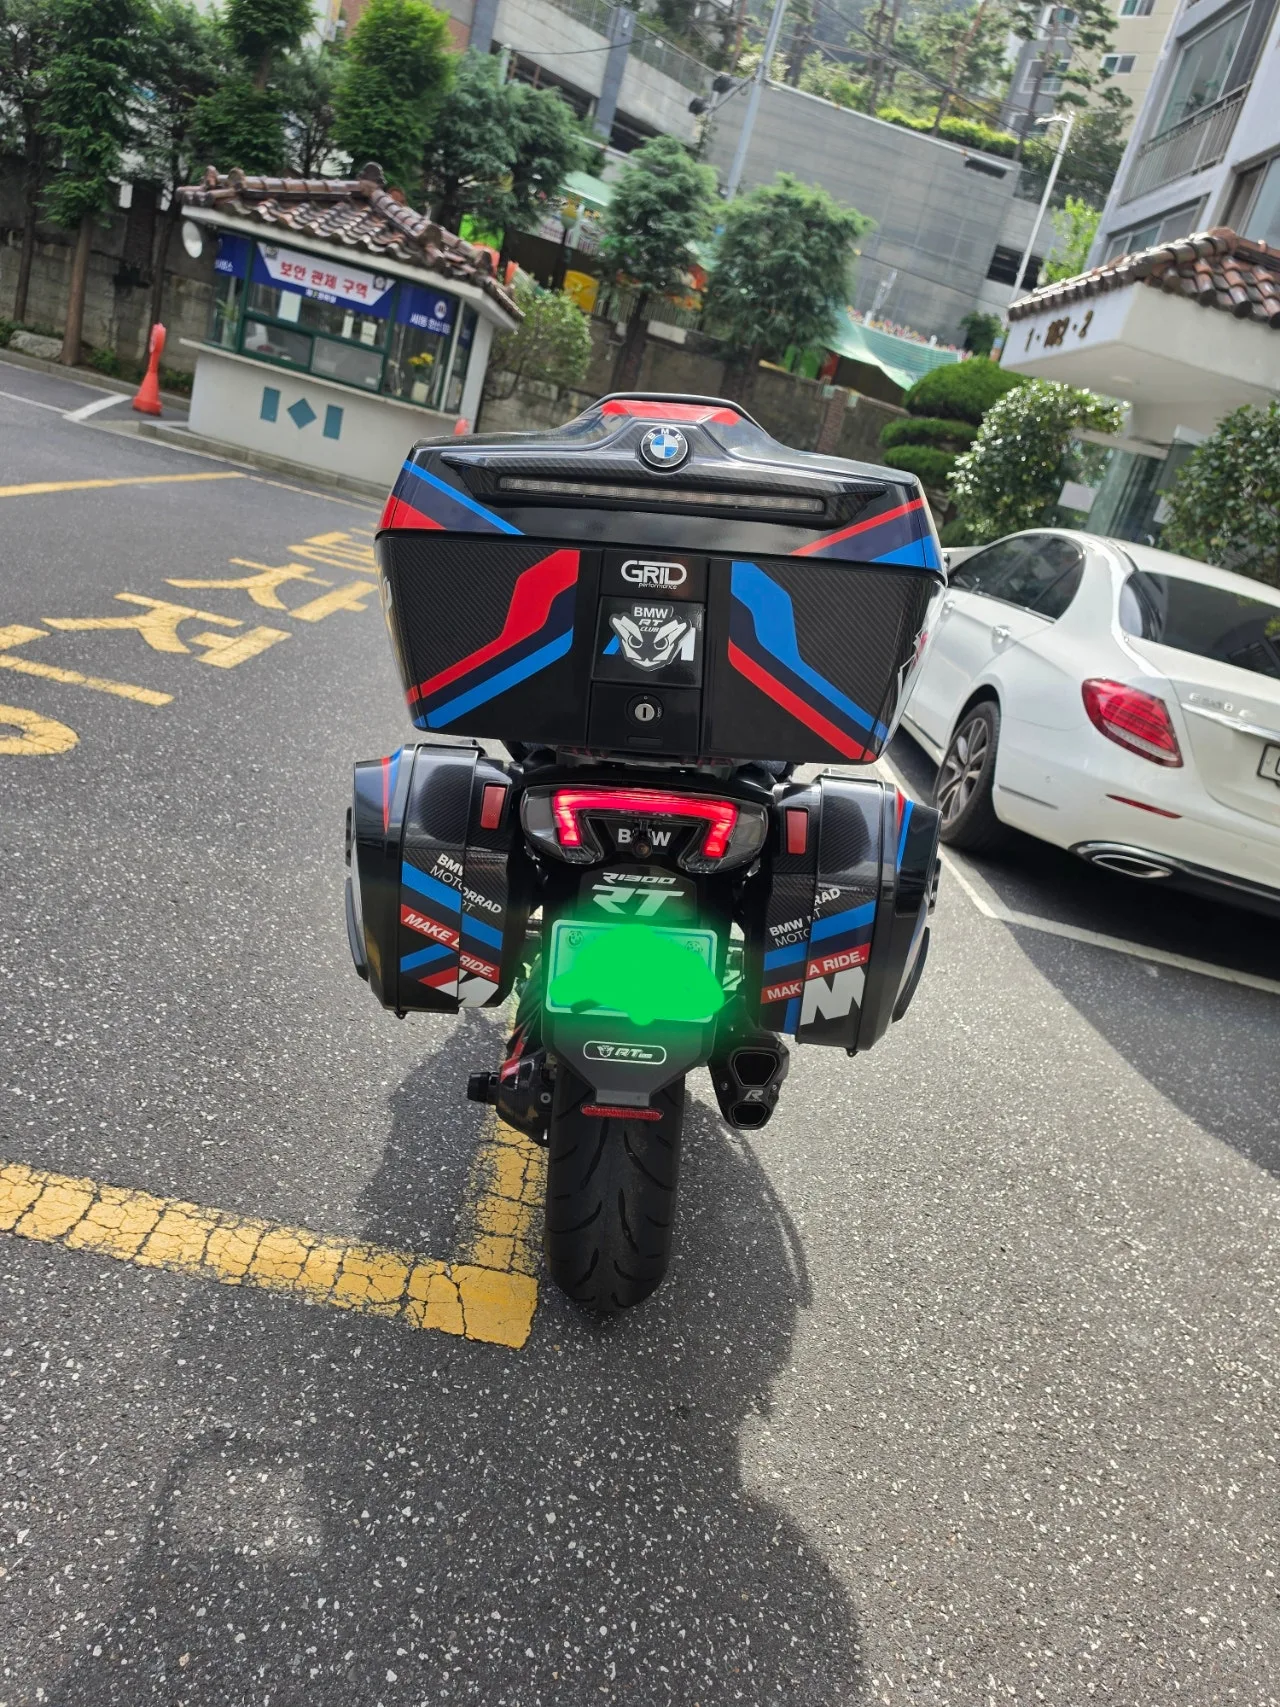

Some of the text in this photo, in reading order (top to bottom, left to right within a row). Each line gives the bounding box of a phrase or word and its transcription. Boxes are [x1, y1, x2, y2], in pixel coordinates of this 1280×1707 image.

[281, 261, 306, 281] 보안
[311, 269, 338, 290] 관제
[343, 279, 369, 299] 구역
[620, 559, 688, 586] GRID
[638, 581, 678, 590] performance
[633, 606, 669, 620] BMW
[638, 618, 664, 627] RT
[617, 828, 672, 847] BW
[602, 871, 677, 885] R1300
[591, 883, 686, 917] RT
[769, 917, 804, 937] BMW
[404, 913, 495, 977] MAKE RIDE.
[766, 950, 866, 1000] MAK A RIDE.
